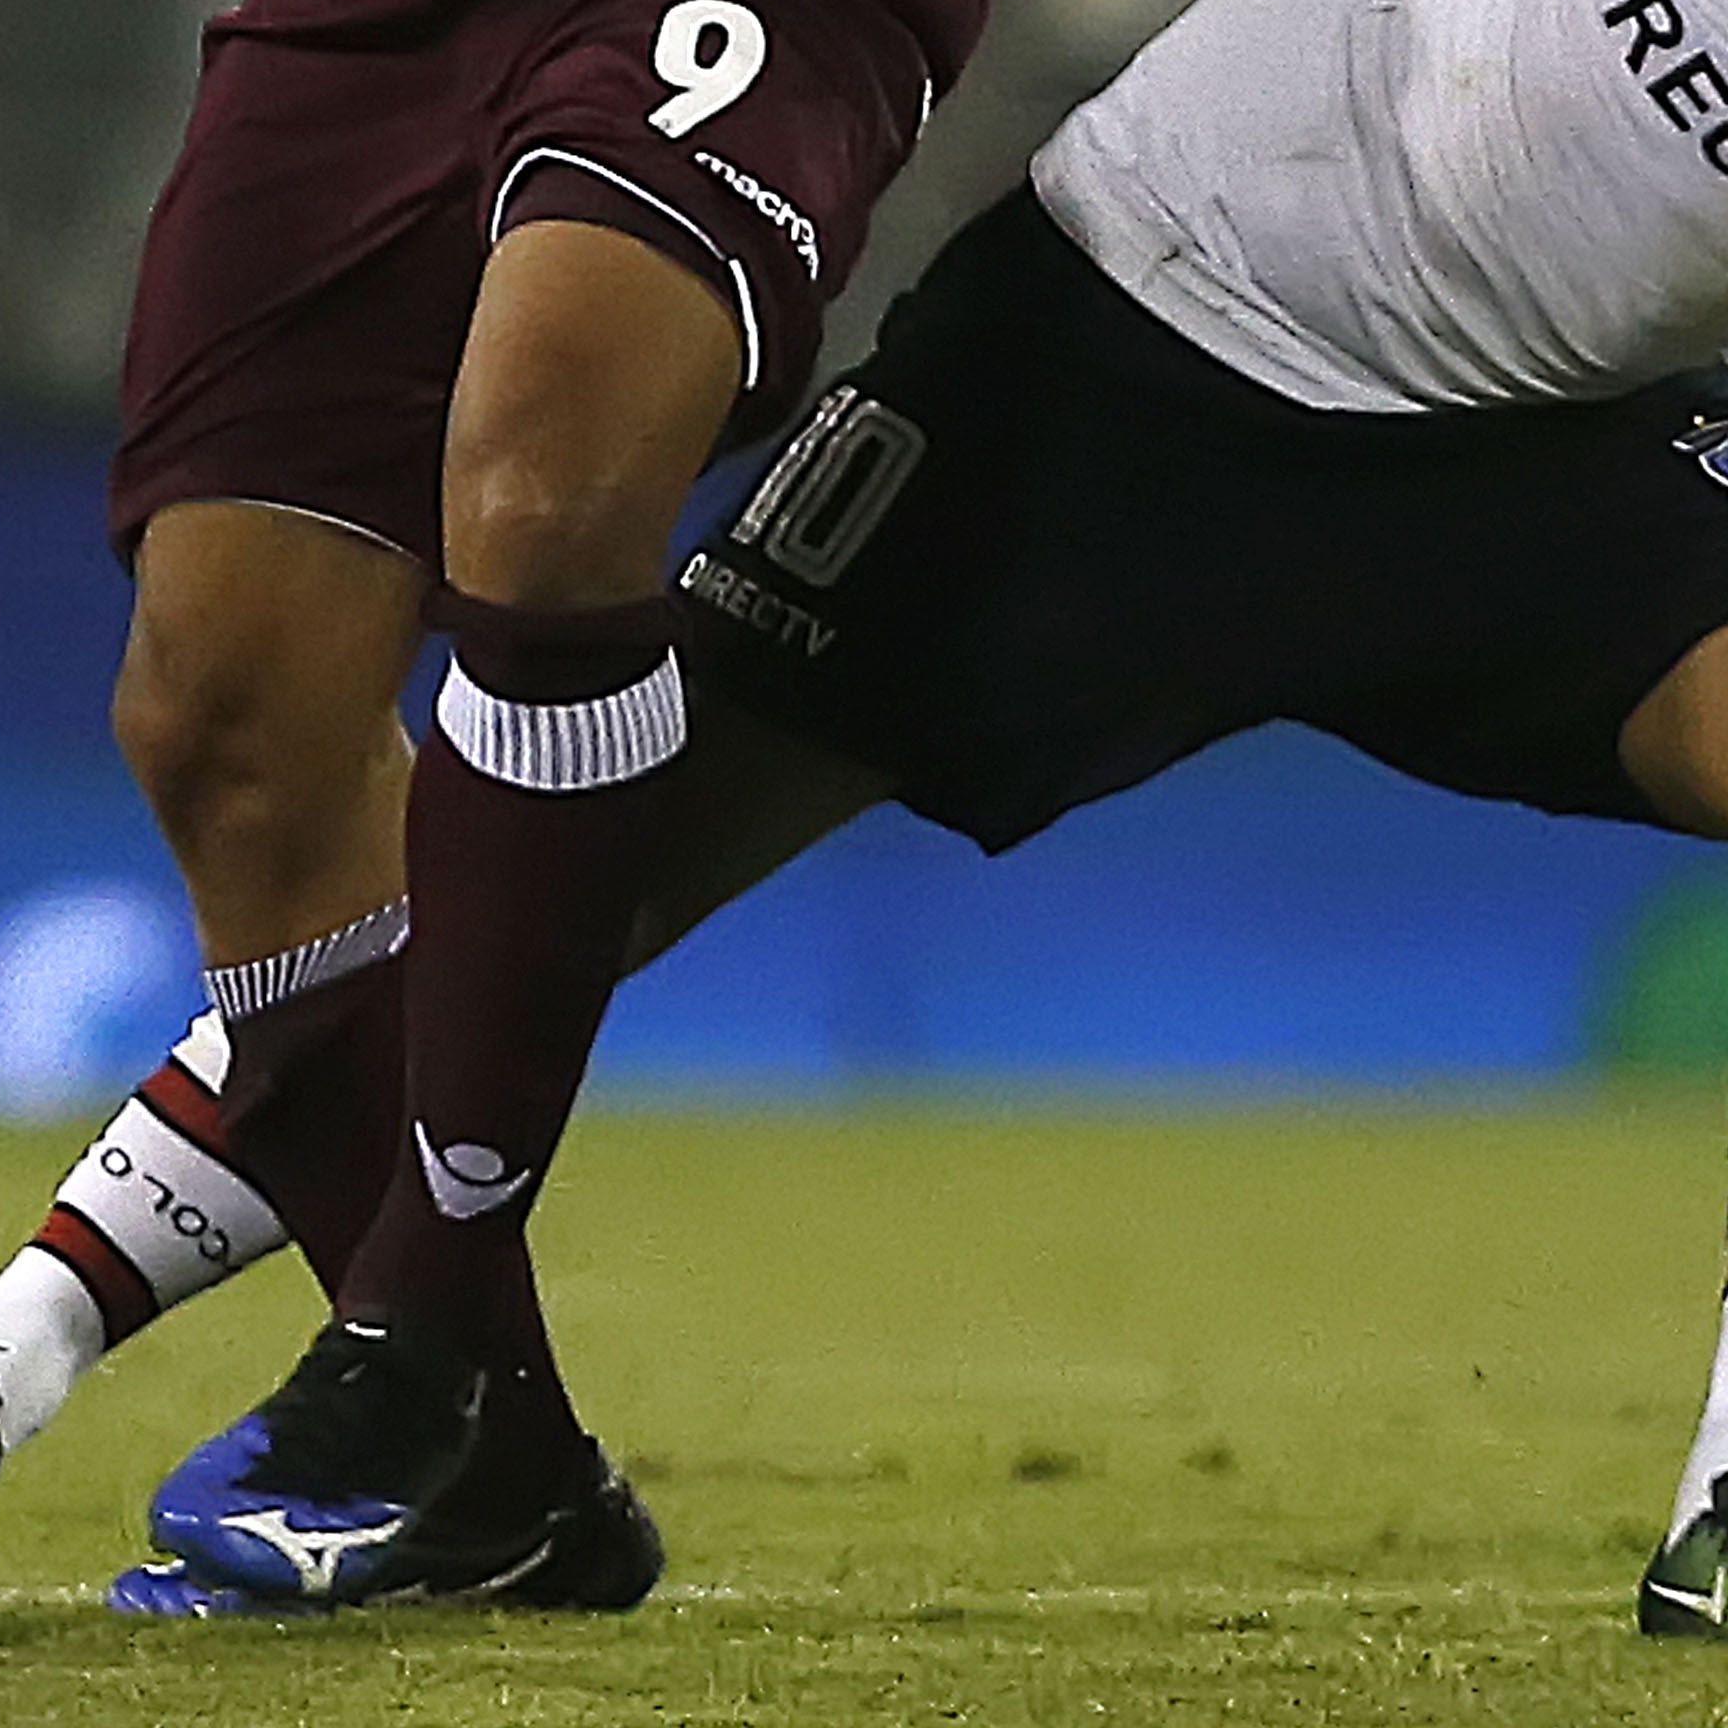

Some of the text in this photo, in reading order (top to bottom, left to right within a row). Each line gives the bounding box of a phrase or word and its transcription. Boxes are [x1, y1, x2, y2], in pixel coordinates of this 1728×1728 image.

[648, 0, 765, 139] 9
[730, 385, 927, 587] 10
[680, 553, 836, 656] DIRECTV
[101, 1147, 229, 1262] COLO
